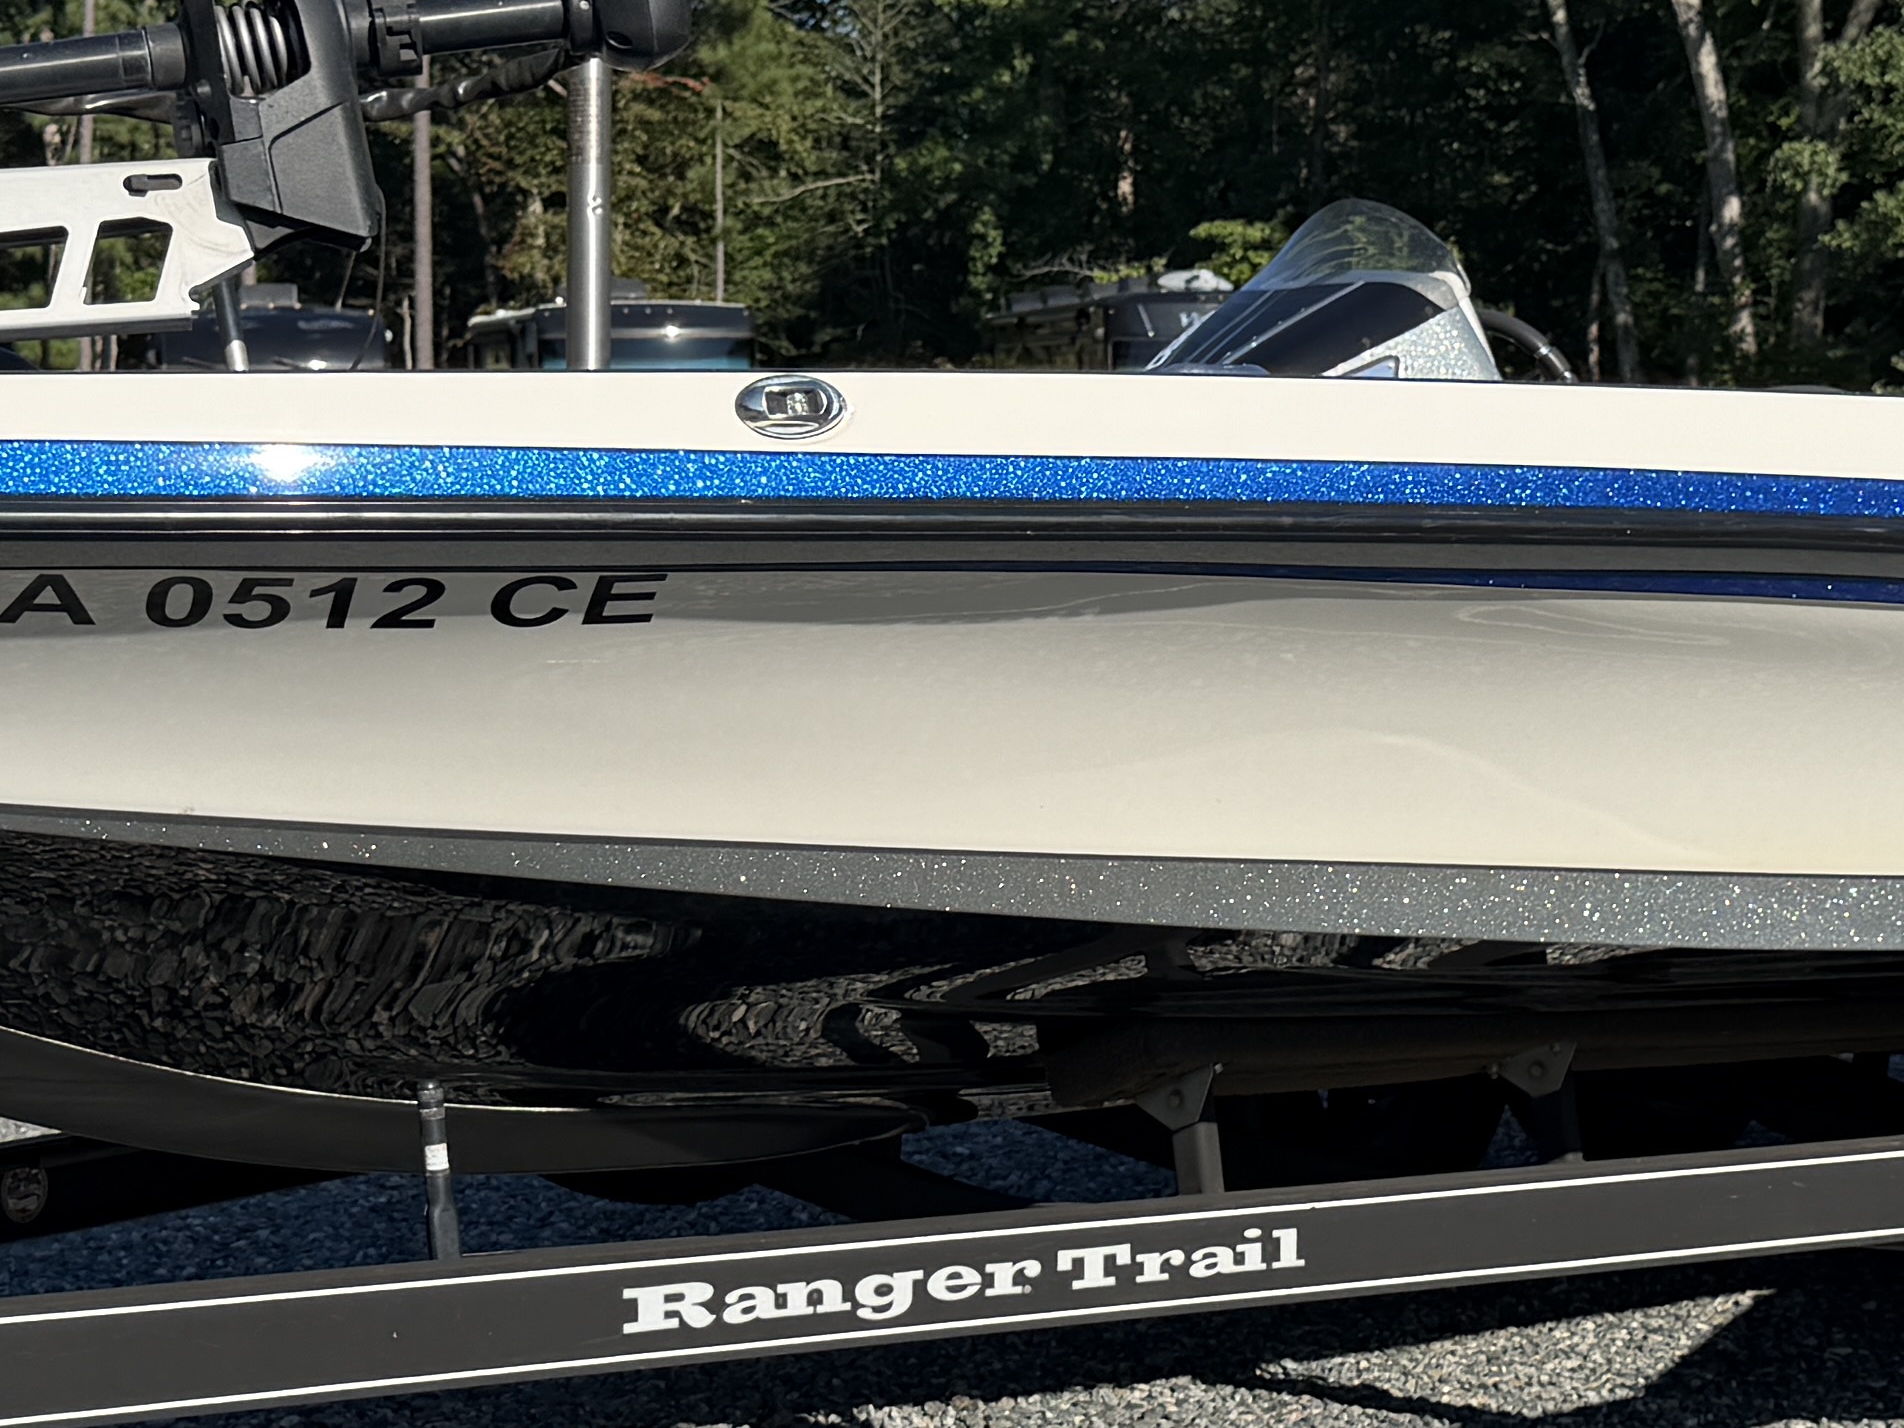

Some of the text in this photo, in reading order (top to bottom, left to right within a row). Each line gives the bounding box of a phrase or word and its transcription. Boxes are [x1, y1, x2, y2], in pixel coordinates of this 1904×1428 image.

[144, 573, 446, 630] 0512
[489, 572, 669, 628] CE
[621, 1228, 1306, 1335] Ranger Trail
